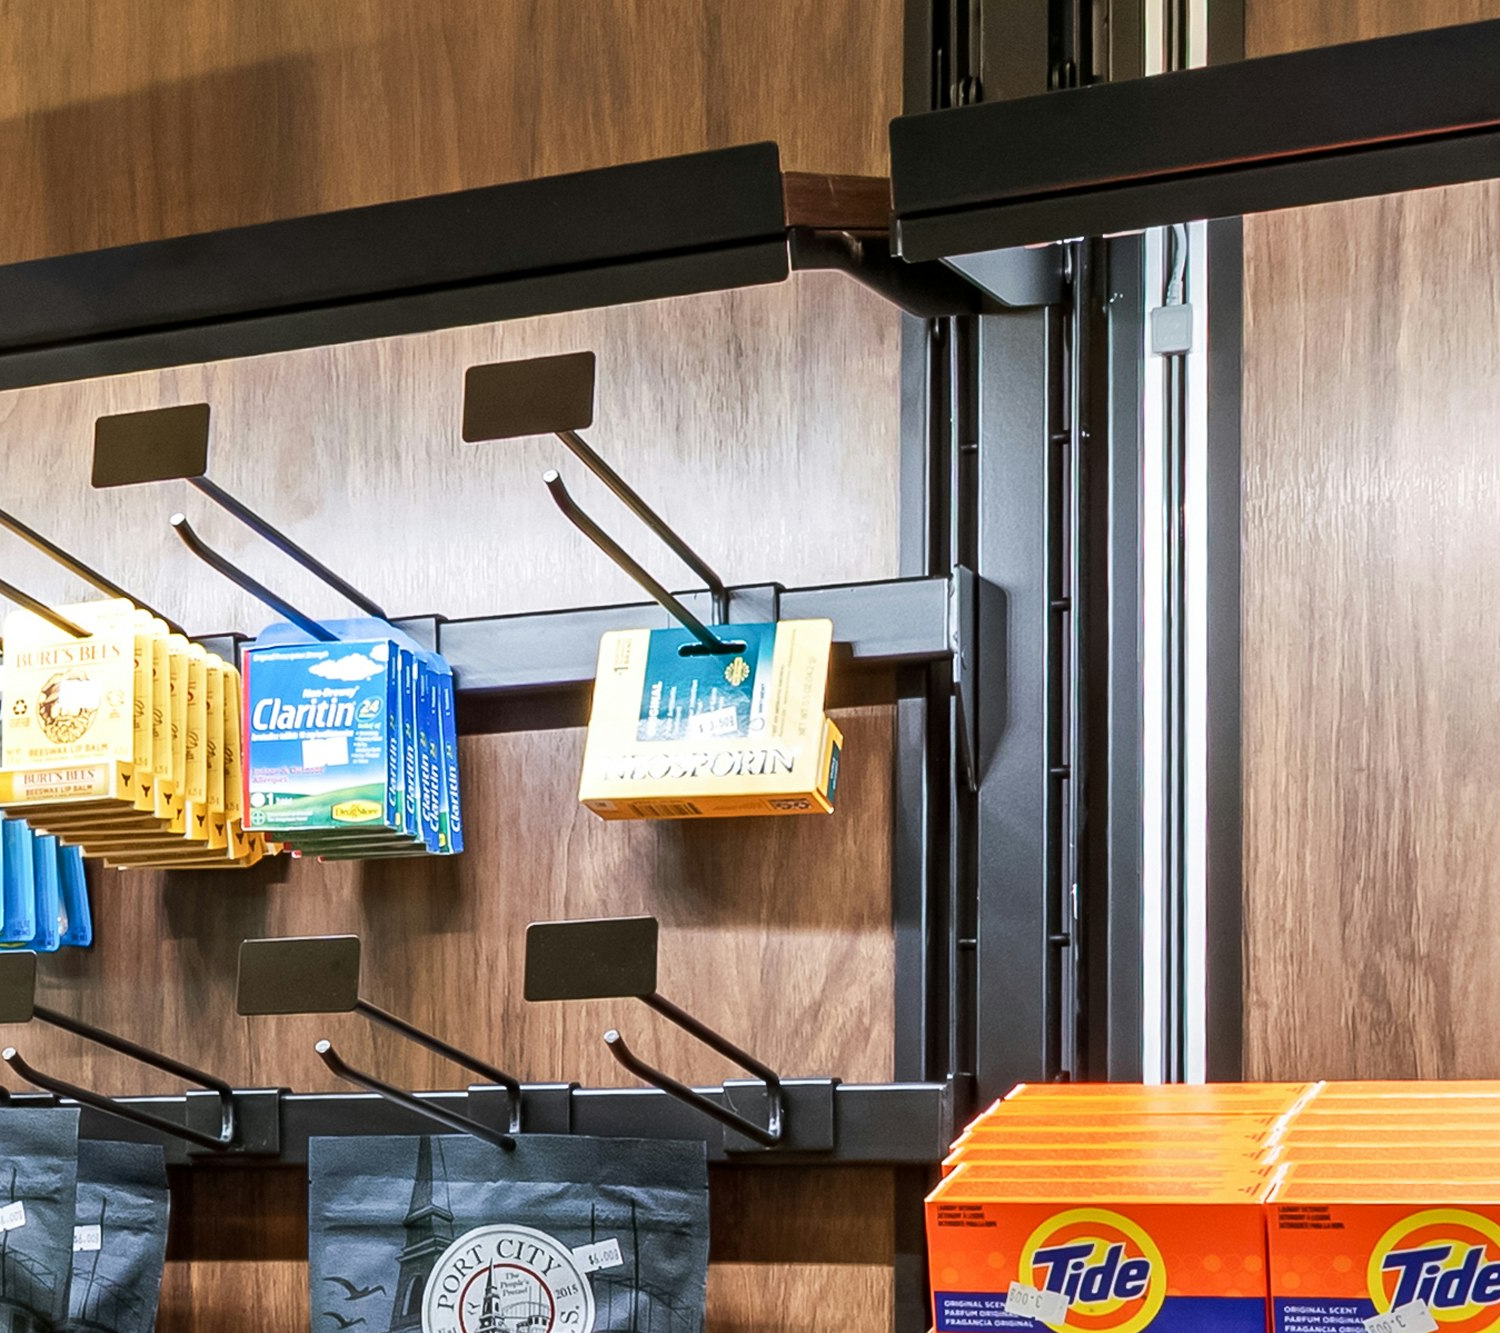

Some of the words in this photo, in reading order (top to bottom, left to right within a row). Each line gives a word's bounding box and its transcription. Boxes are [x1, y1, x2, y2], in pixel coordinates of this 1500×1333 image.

[252, 697, 355, 732] Claritin
[66, 769, 95, 780] BEES
[388, 737, 398, 807] Claritin
[26, 787, 59, 796] BEESWAX
[73, 784, 93, 792] BALM
[438, 1244, 484, 1311] PORT
[496, 1239, 562, 1277] CITY
[1032, 1242, 1152, 1306] Tide
[555, 1284, 579, 1300] 2015
[1284, 1306, 1327, 1315] ORIGINAL
[1329, 1306, 1357, 1315] SCENT
[945, 1319, 993, 1327] FRAGANCIA
[995, 1319, 1033, 1328] ORIGINAL
[1284, 1315, 1322, 1324] PARFUM
[1324, 1316, 1365, 1324] ORIGINAL
